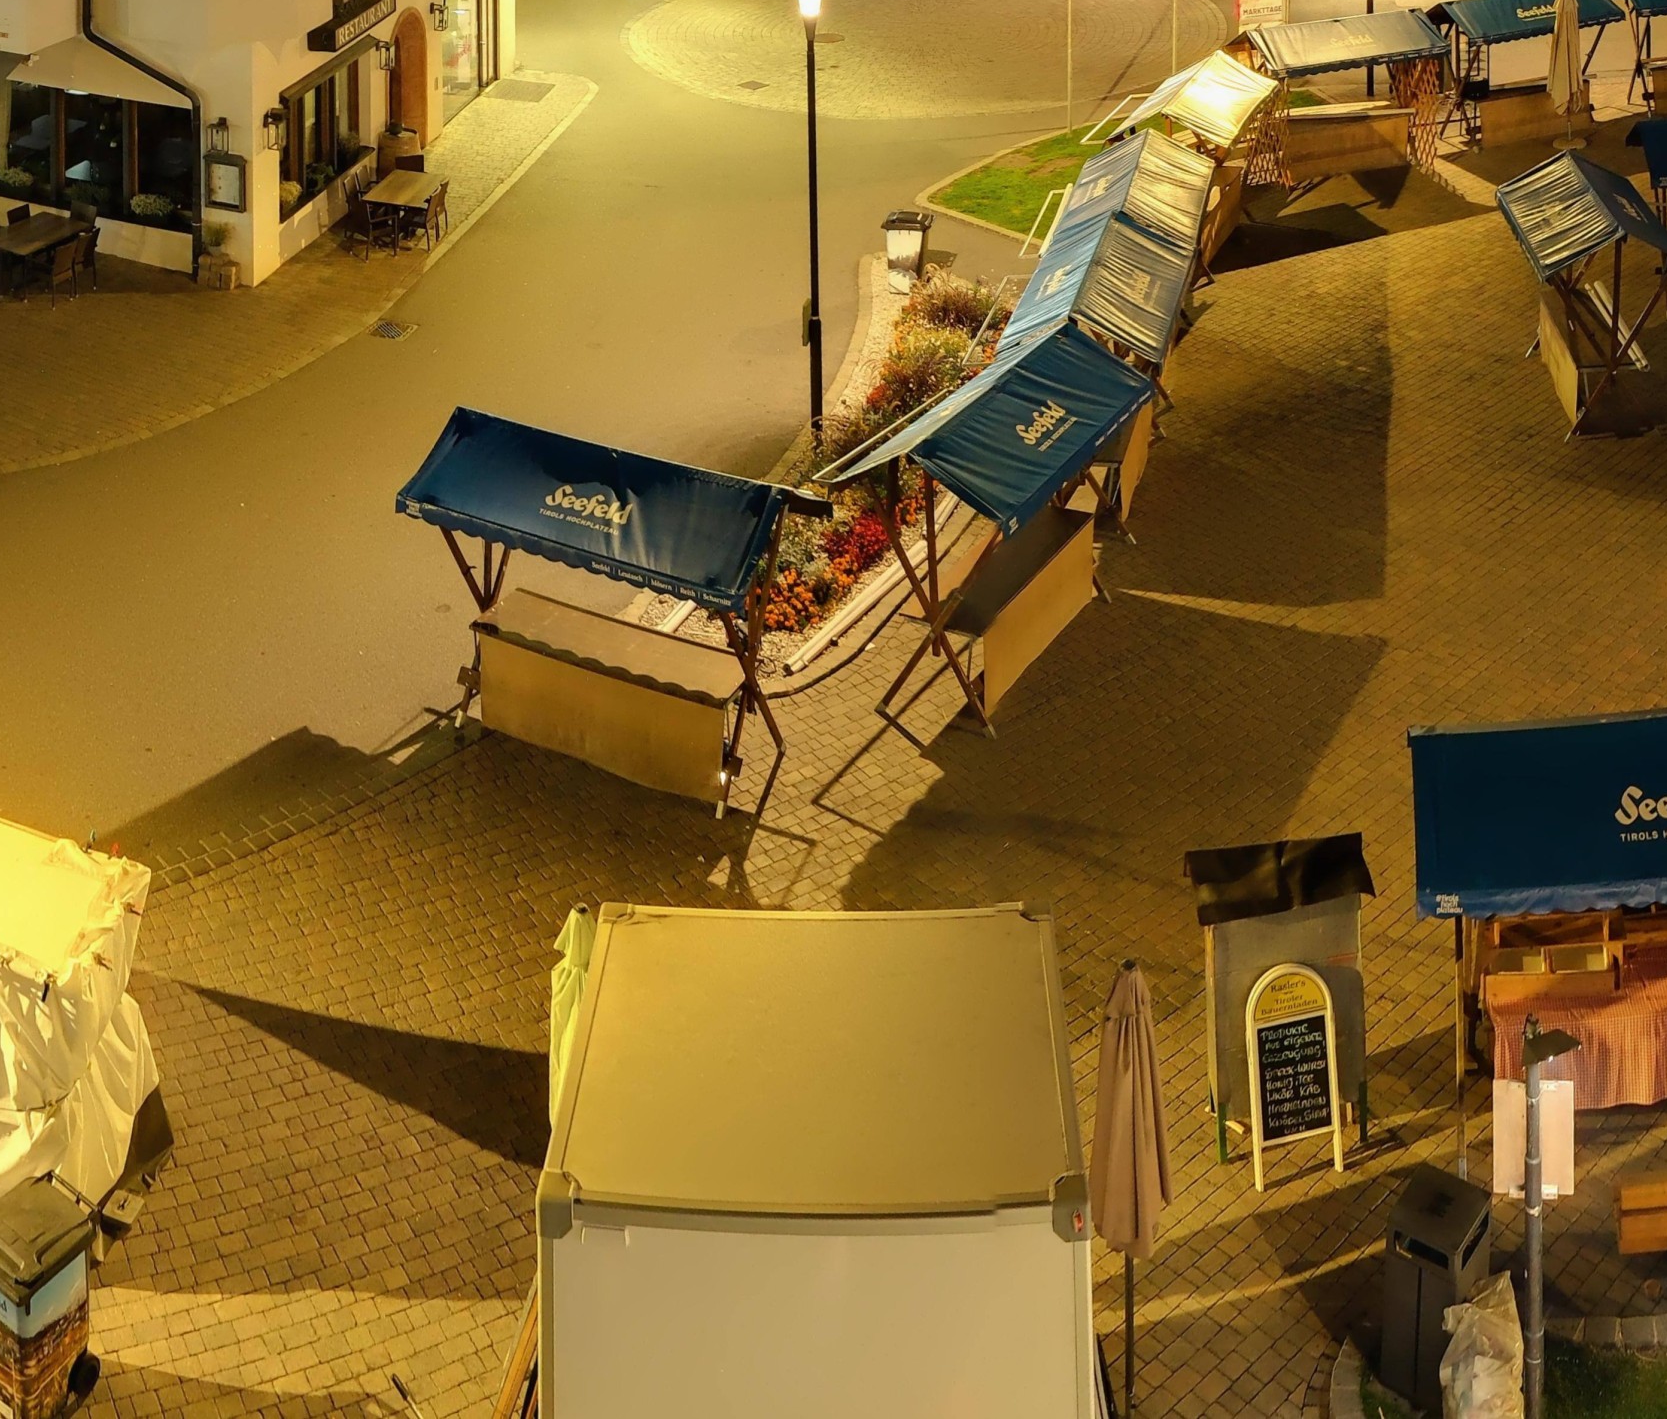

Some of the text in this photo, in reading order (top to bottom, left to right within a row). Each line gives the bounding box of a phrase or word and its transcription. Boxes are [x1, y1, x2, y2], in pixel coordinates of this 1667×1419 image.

[1243, 5, 1282, 16] MARKTTAGE
[1517, 5, 1557, 19] Seefeld
[1016, 400, 1066, 445] Seefeld
[545, 485, 633, 525] Seefeld
[539, 508, 619, 535] TIROLS HOCHPLATEAU
[1620, 830, 1659, 843] TIROLS
[1261, 999, 1318, 1016] Bauernladen
[1274, 994, 1304, 1006] Tiroler
